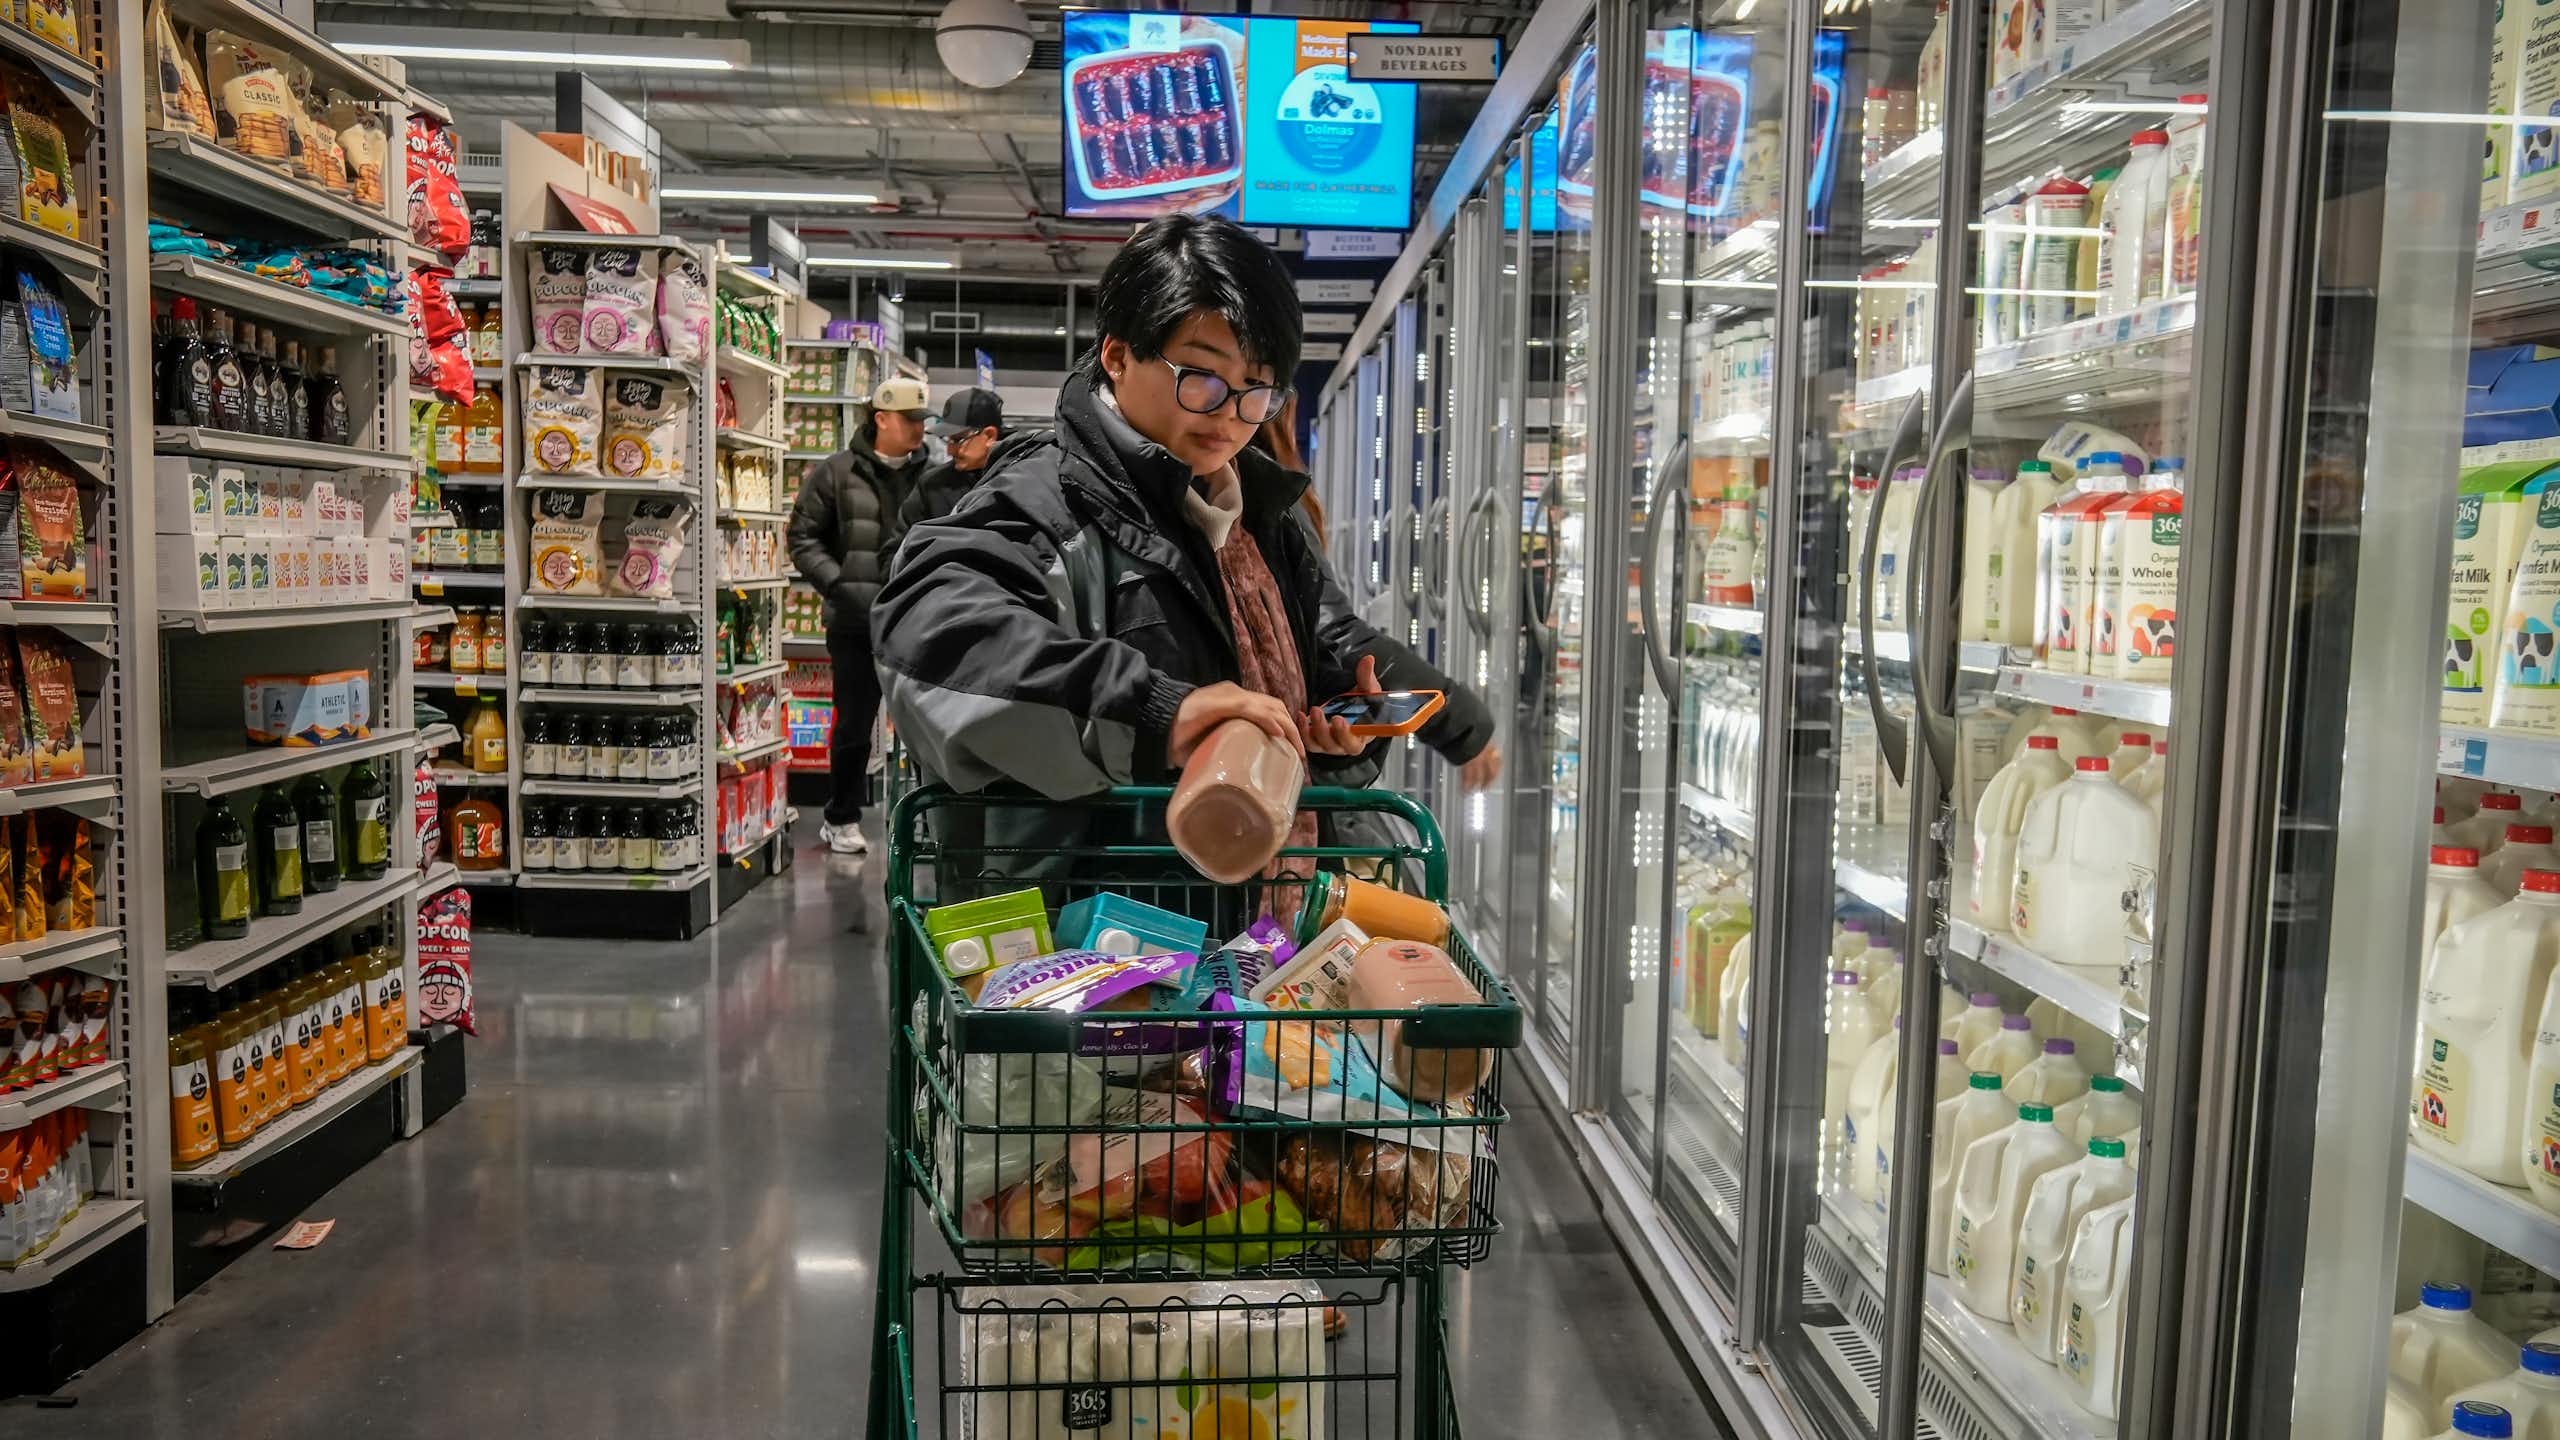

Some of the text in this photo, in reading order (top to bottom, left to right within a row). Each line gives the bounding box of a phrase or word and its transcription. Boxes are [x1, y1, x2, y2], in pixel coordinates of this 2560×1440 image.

[1302, 46, 1334, 58] Made
[1384, 45, 1463, 57] NONDAIRY
[1381, 60, 1467, 71] BEVERAGES
[243, 89, 281, 105] CLASSIC
[1304, 124, 1354, 136] Dolmas
[535, 285, 586, 298] POPCO
[2132, 567, 2173, 578] Whole
[2466, 568, 2491, 583] Milk
[321, 694, 346, 708] ATHLETIC
[990, 953, 1118, 1007] Milton's
[1071, 1389, 1106, 1413] 365
